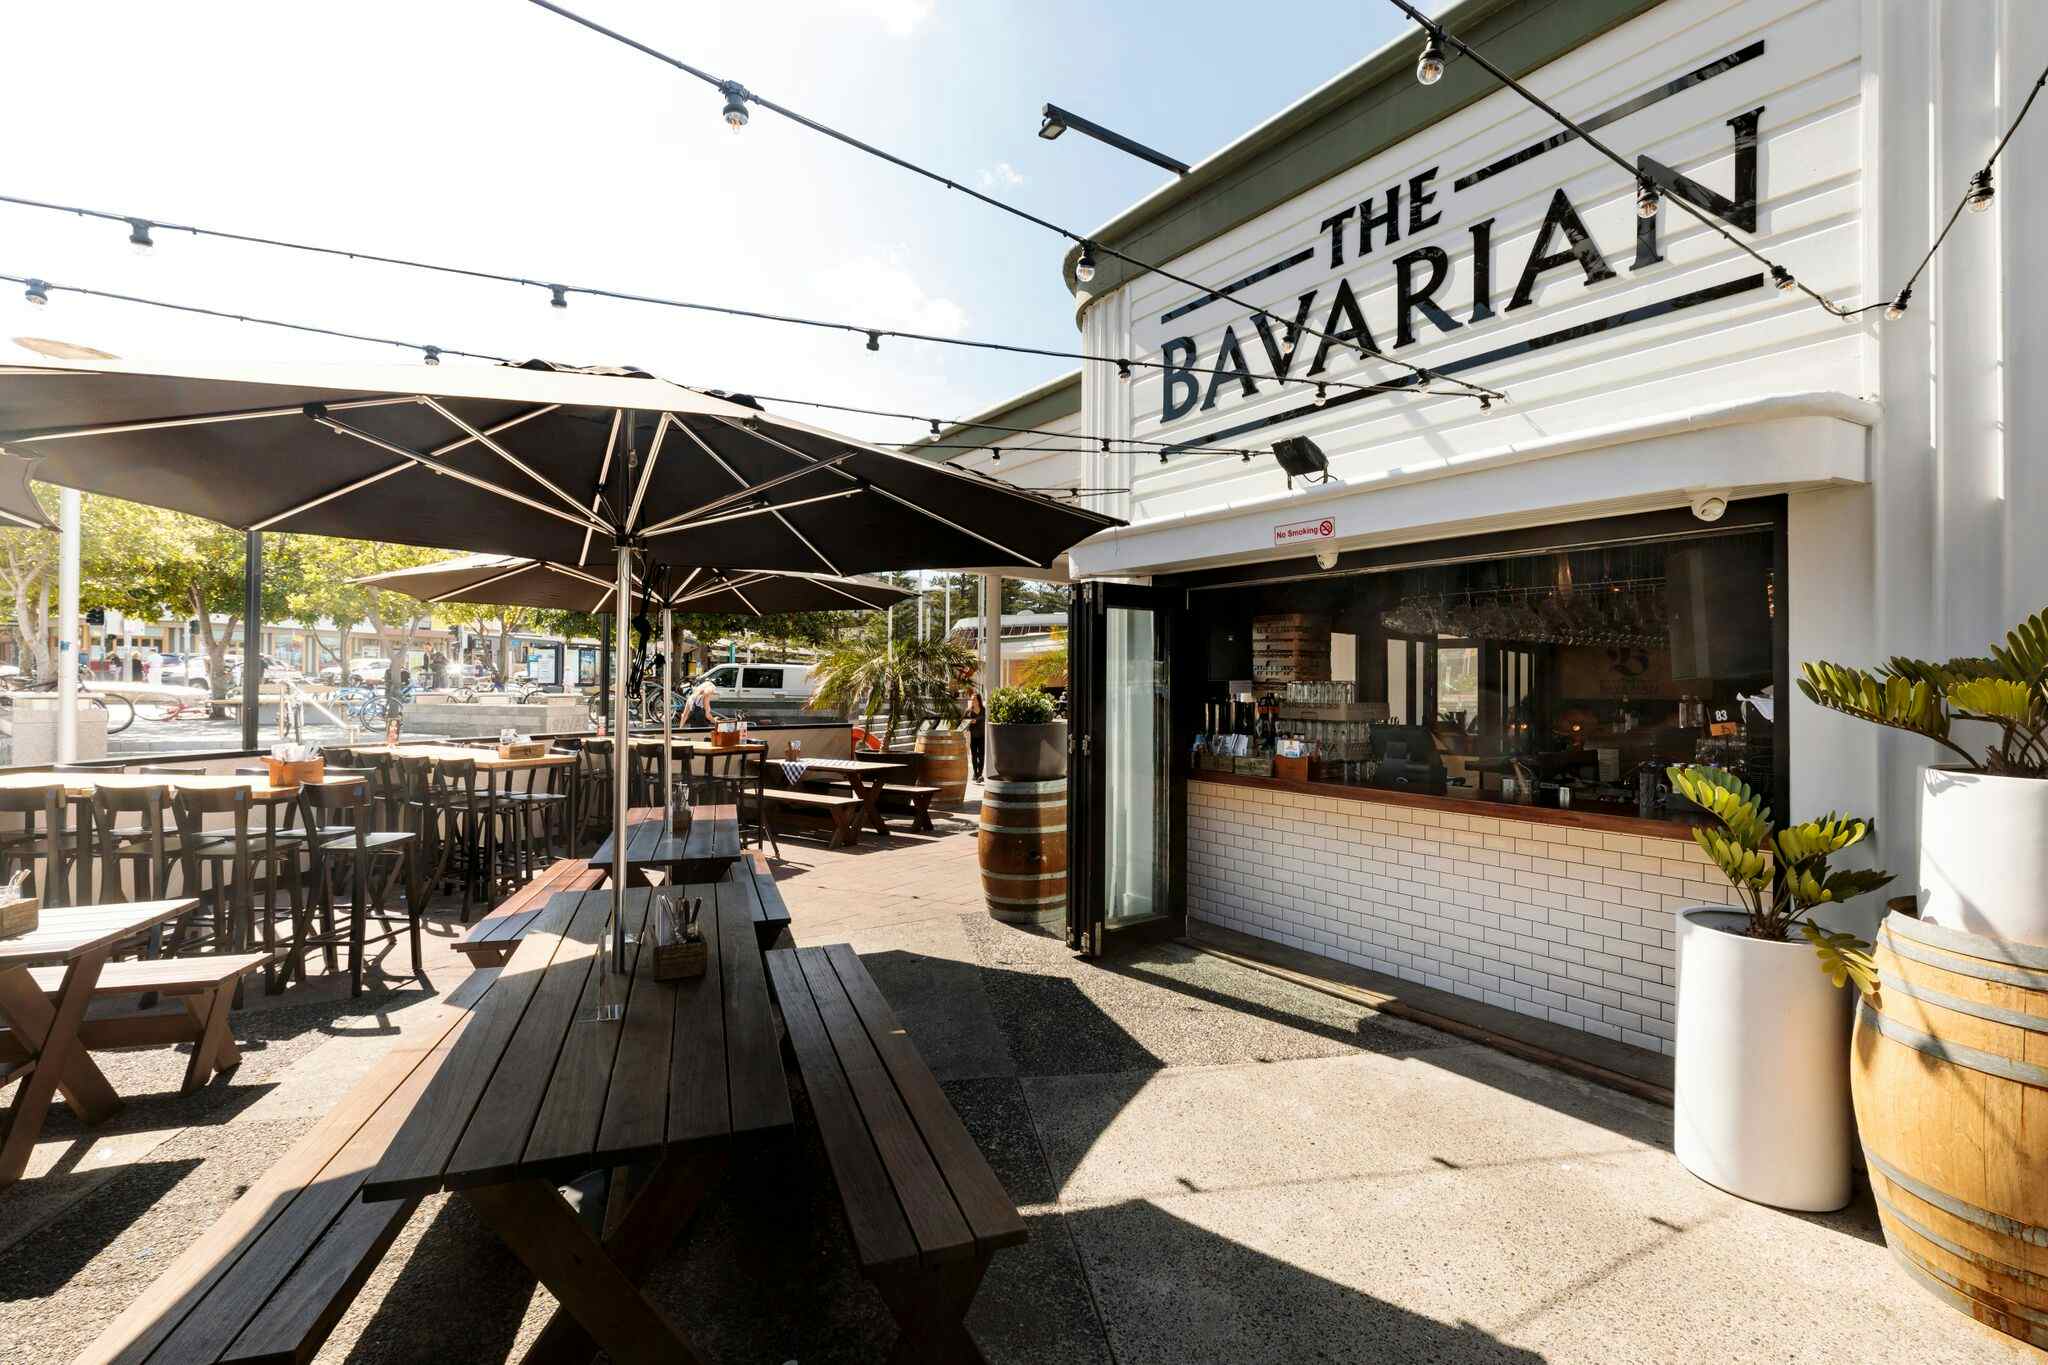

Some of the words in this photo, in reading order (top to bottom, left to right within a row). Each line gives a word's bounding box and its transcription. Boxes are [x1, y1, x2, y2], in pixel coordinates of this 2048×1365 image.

[1320, 166, 1441, 269] THE
[1160, 105, 1765, 423] BAVARIAN
[1276, 531, 1286, 540] No
[1287, 527, 1318, 537] Smoking
[1715, 710, 1728, 721] 83
